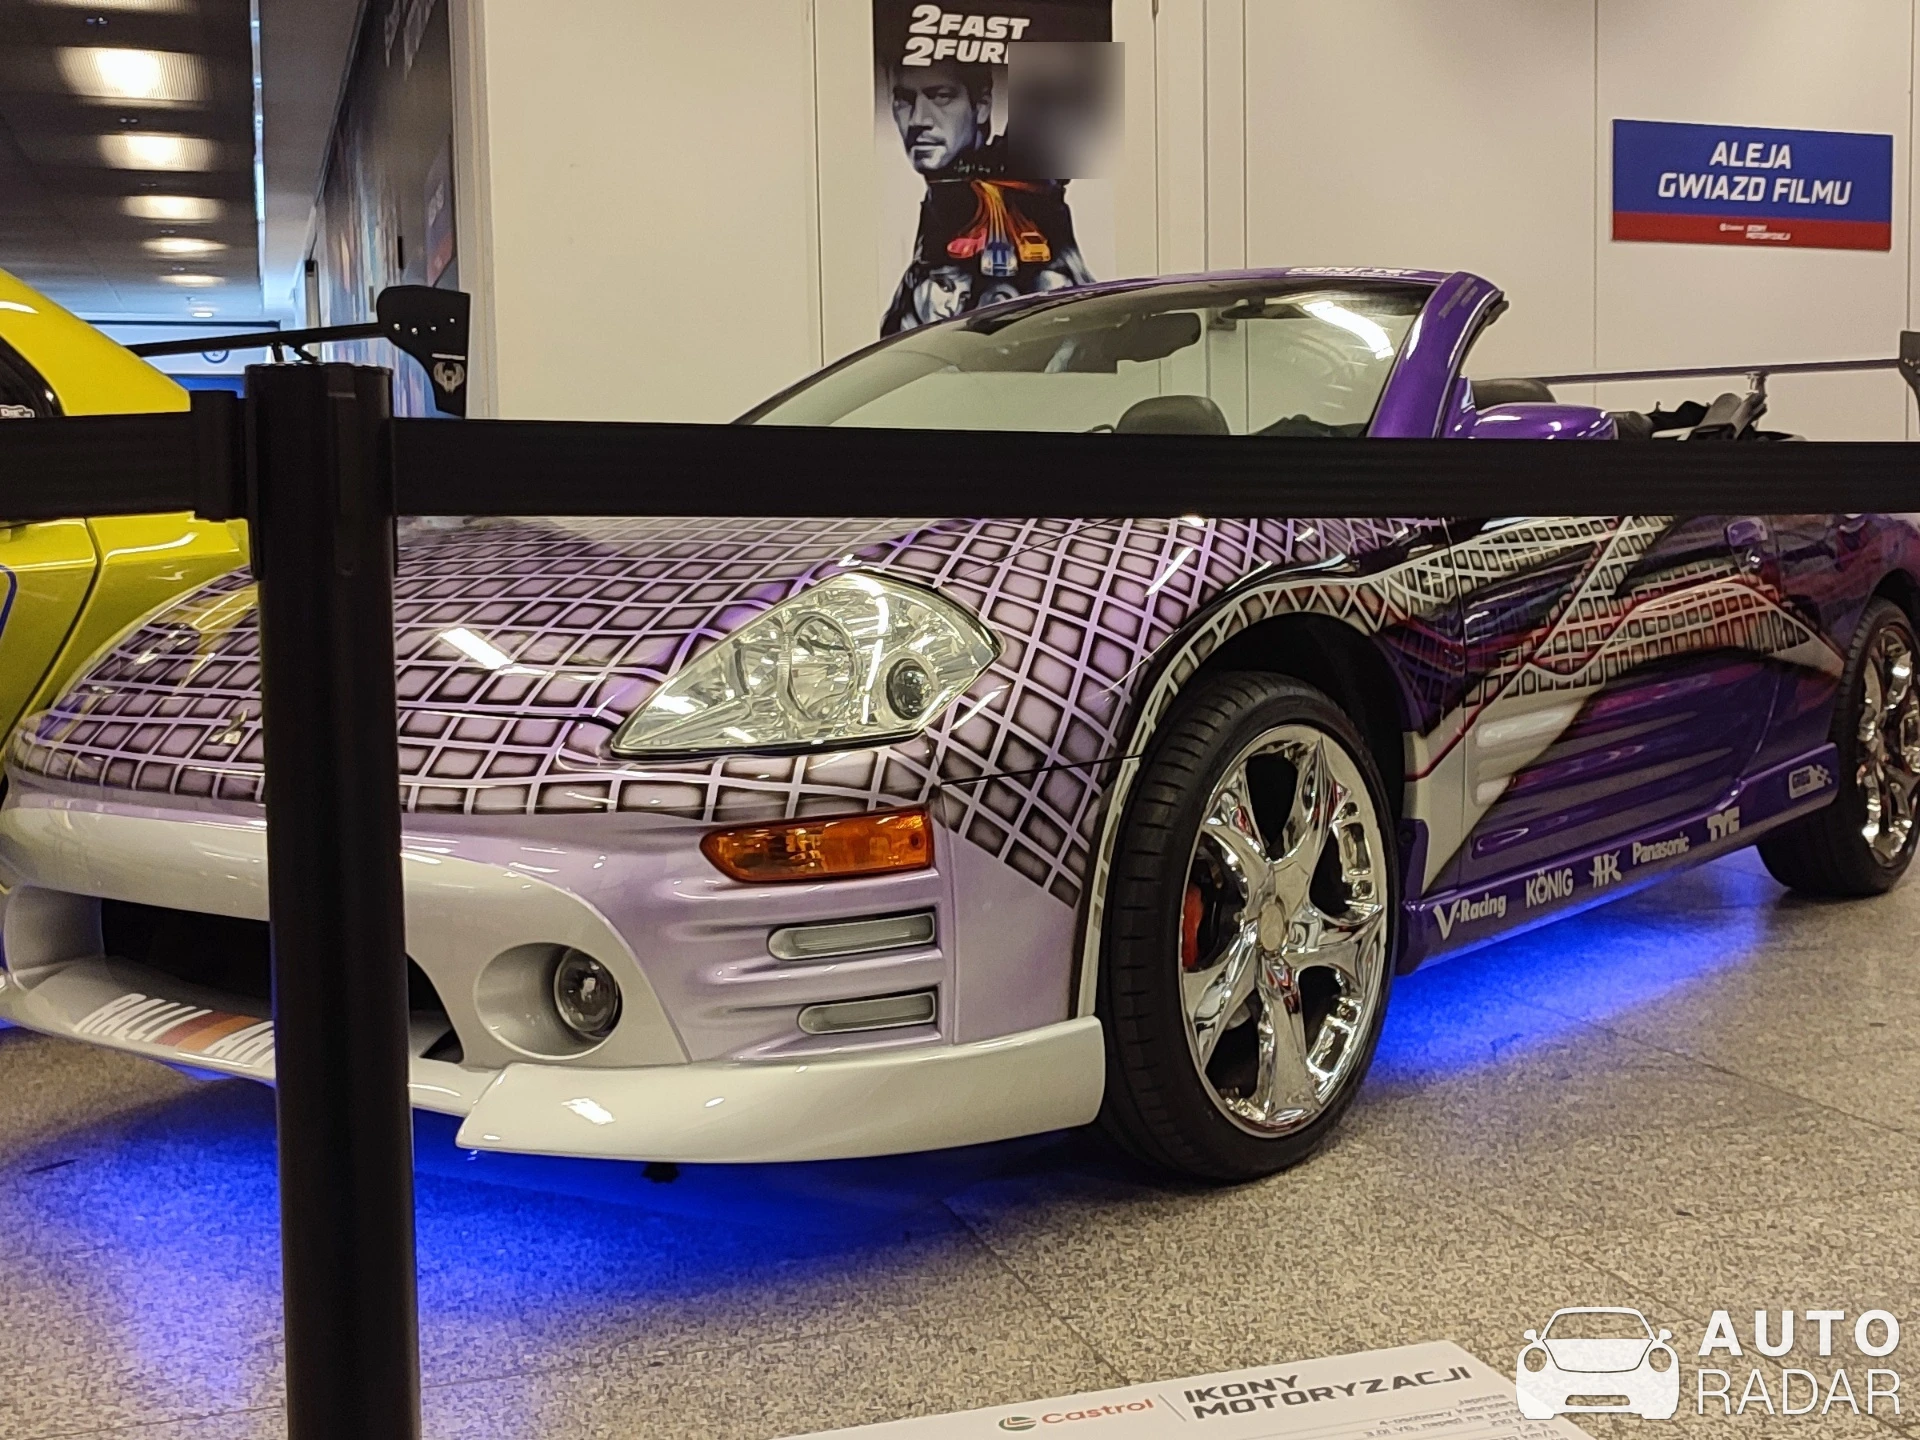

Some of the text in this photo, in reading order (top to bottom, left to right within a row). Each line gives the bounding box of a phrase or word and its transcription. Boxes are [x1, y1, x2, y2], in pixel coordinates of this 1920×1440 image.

[1709, 141, 1792, 170] ALEJA
[1658, 172, 1852, 206] GWIAZD FILMU
[1526, 868, 1574, 909] KÖNIG
[1633, 831, 1690, 865] Panasonic
[1184, 1374, 1298, 1404] IKONY
[1192, 1366, 1472, 1419] MOTORYZACJI
[1041, 1399, 1154, 1424] Castrol
